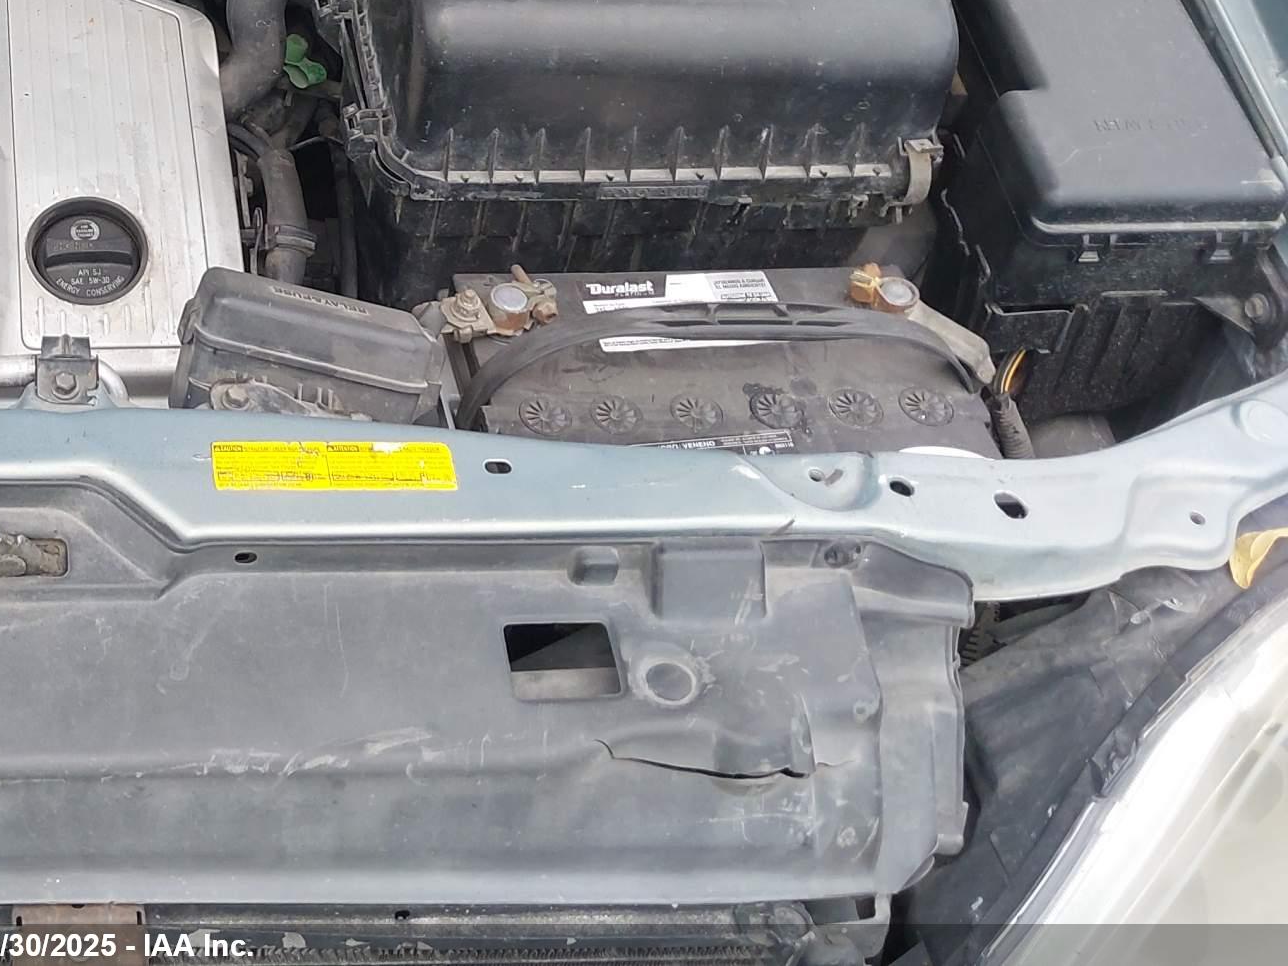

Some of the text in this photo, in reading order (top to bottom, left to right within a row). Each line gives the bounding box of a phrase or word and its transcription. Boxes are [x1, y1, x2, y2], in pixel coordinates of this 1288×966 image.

[56, 275, 126, 297] ENERGY CONSERVING
[71, 276, 110, 285] SAE 5W-30
[585, 280, 654, 296] Duralast
